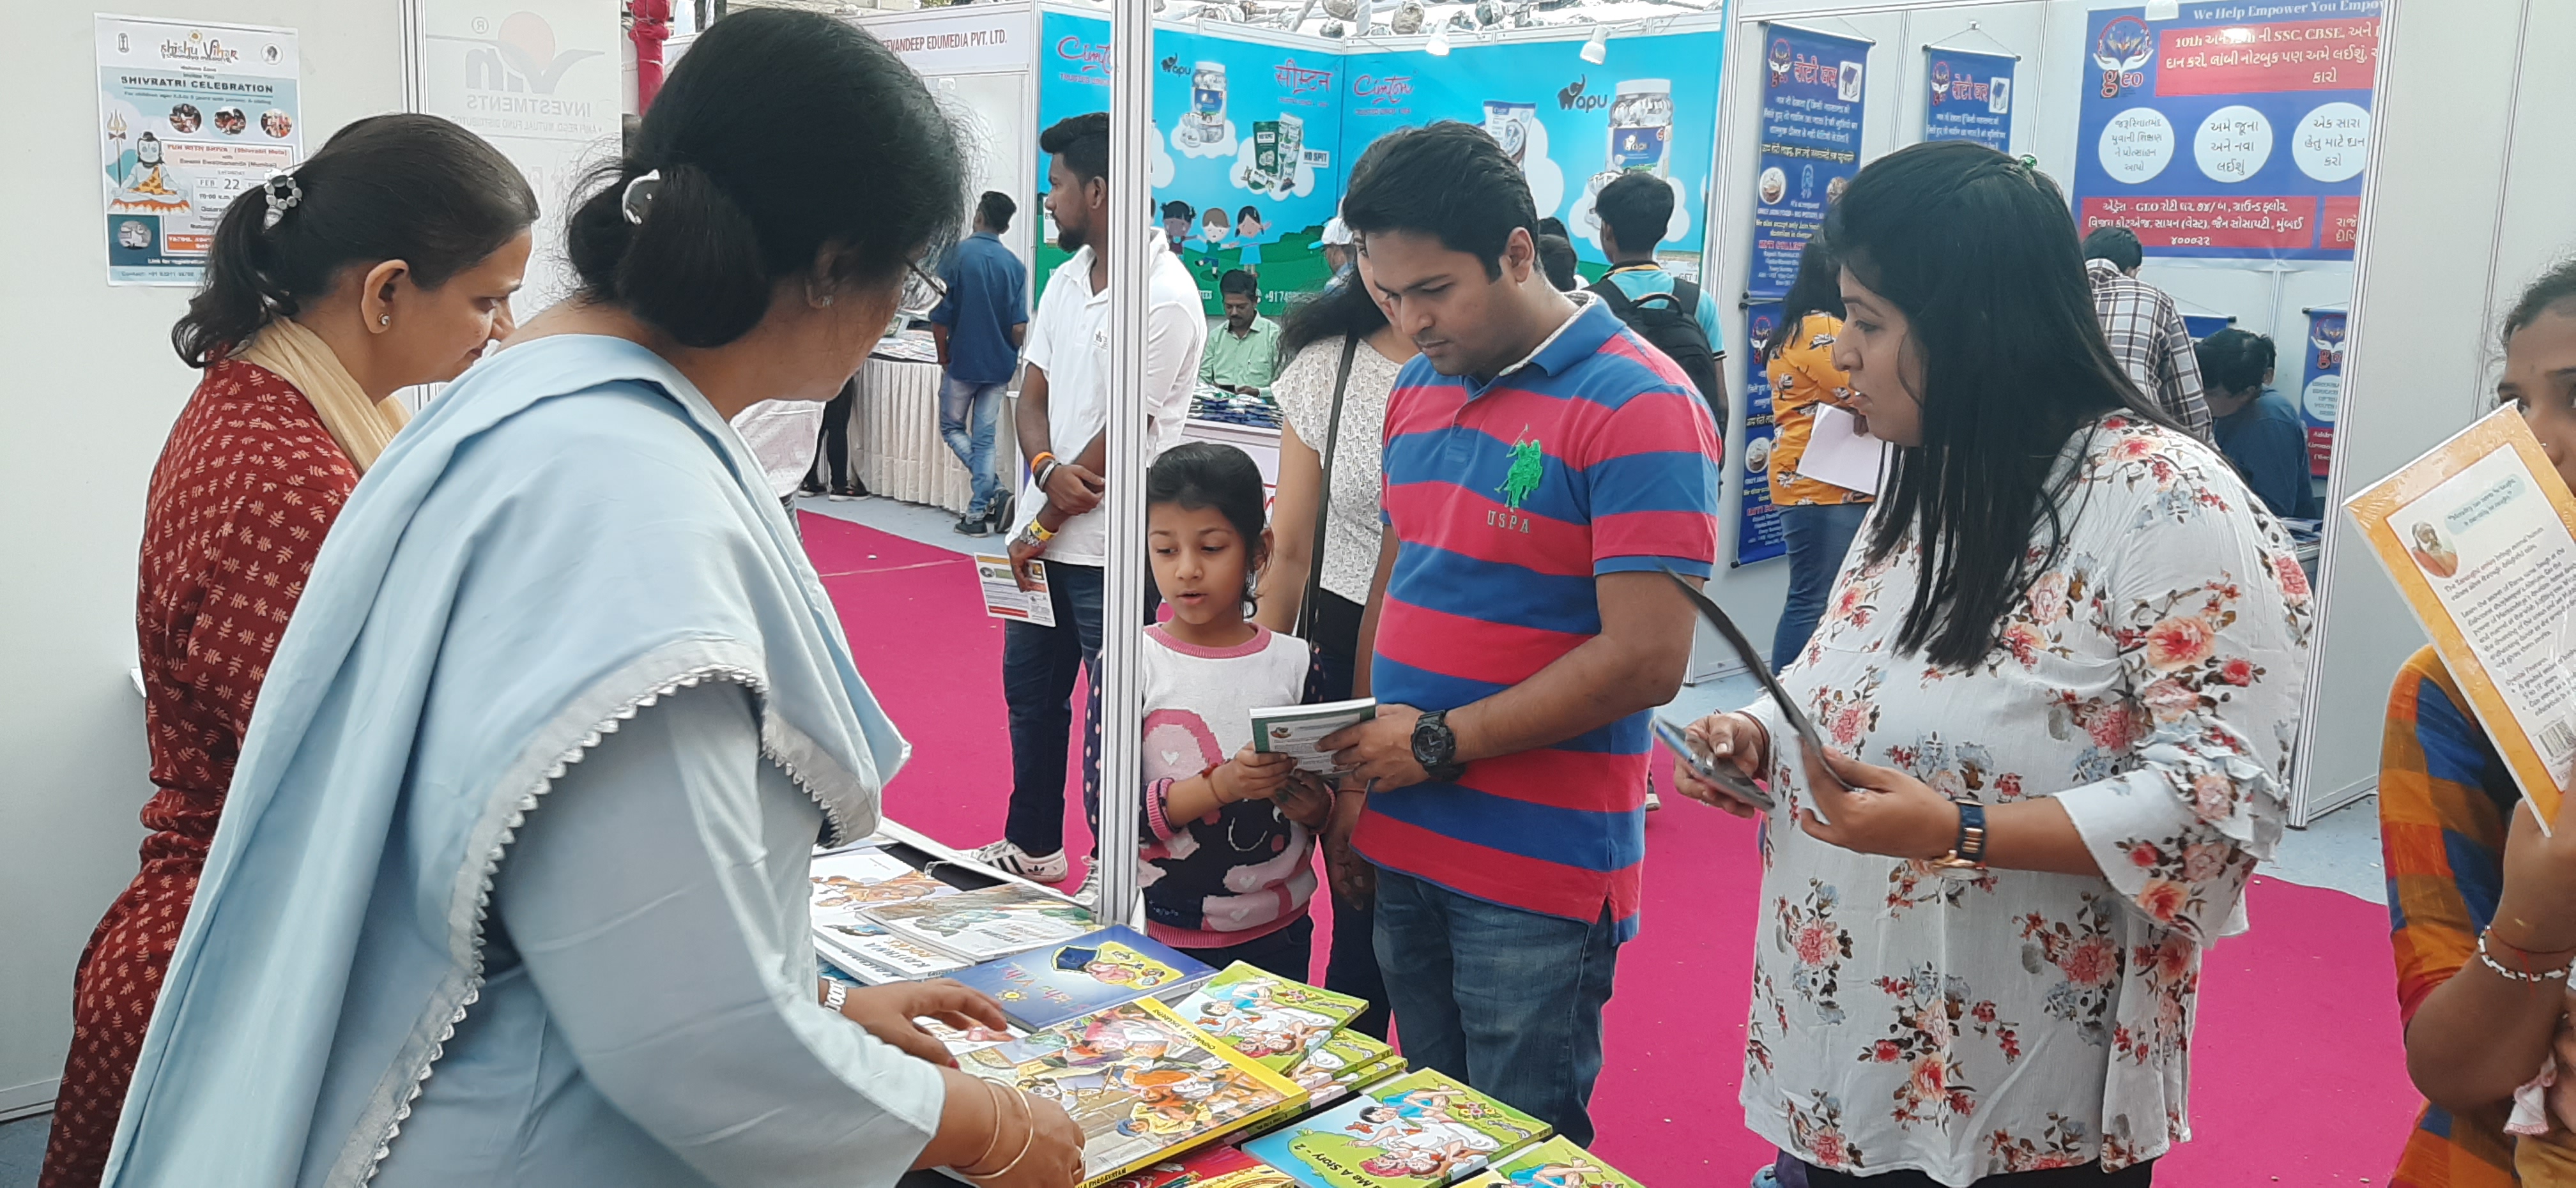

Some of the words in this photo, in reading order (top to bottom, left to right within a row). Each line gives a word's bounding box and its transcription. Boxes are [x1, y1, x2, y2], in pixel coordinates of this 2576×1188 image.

[2194, 10, 2212, 19] We
[2215, 8, 2245, 20] Help
[2248, 4, 2308, 19] Empower
[2312, 1, 2334, 11] You
[927, 34, 968, 50] EDUMEDIA
[970, 31, 988, 46] PVT.
[990, 29, 1007, 45] LTD.
[2175, 36, 2202, 47] 10th
[2166, 56, 2184, 68] દાન
[2241, 49, 2280, 67] નોટબુક
[2306, 48, 2331, 61] અમે
[121, 76, 187, 88] SHIVRATRI
[191, 80, 274, 93] CELEBRATION
[2101, 70, 2143, 98] geo
[2211, 118, 2230, 132] અમે
[2235, 121, 2258, 135] જૂના
[2313, 116, 2332, 128] એક
[2336, 118, 2360, 128] સારા
[2211, 138, 2230, 152] અને
[2234, 142, 2254, 152] નવા
[2325, 135, 2344, 148] માટે
[2217, 158, 2245, 175] લઈશું
[2324, 153, 2342, 167] કરો
[200, 179, 215, 187] FEB
[224, 178, 240, 190] 22
[1487, 510, 1529, 533] USPA
[1311, 1152, 1343, 1171] Story
[1352, 1174, 1374, 1187] Me
